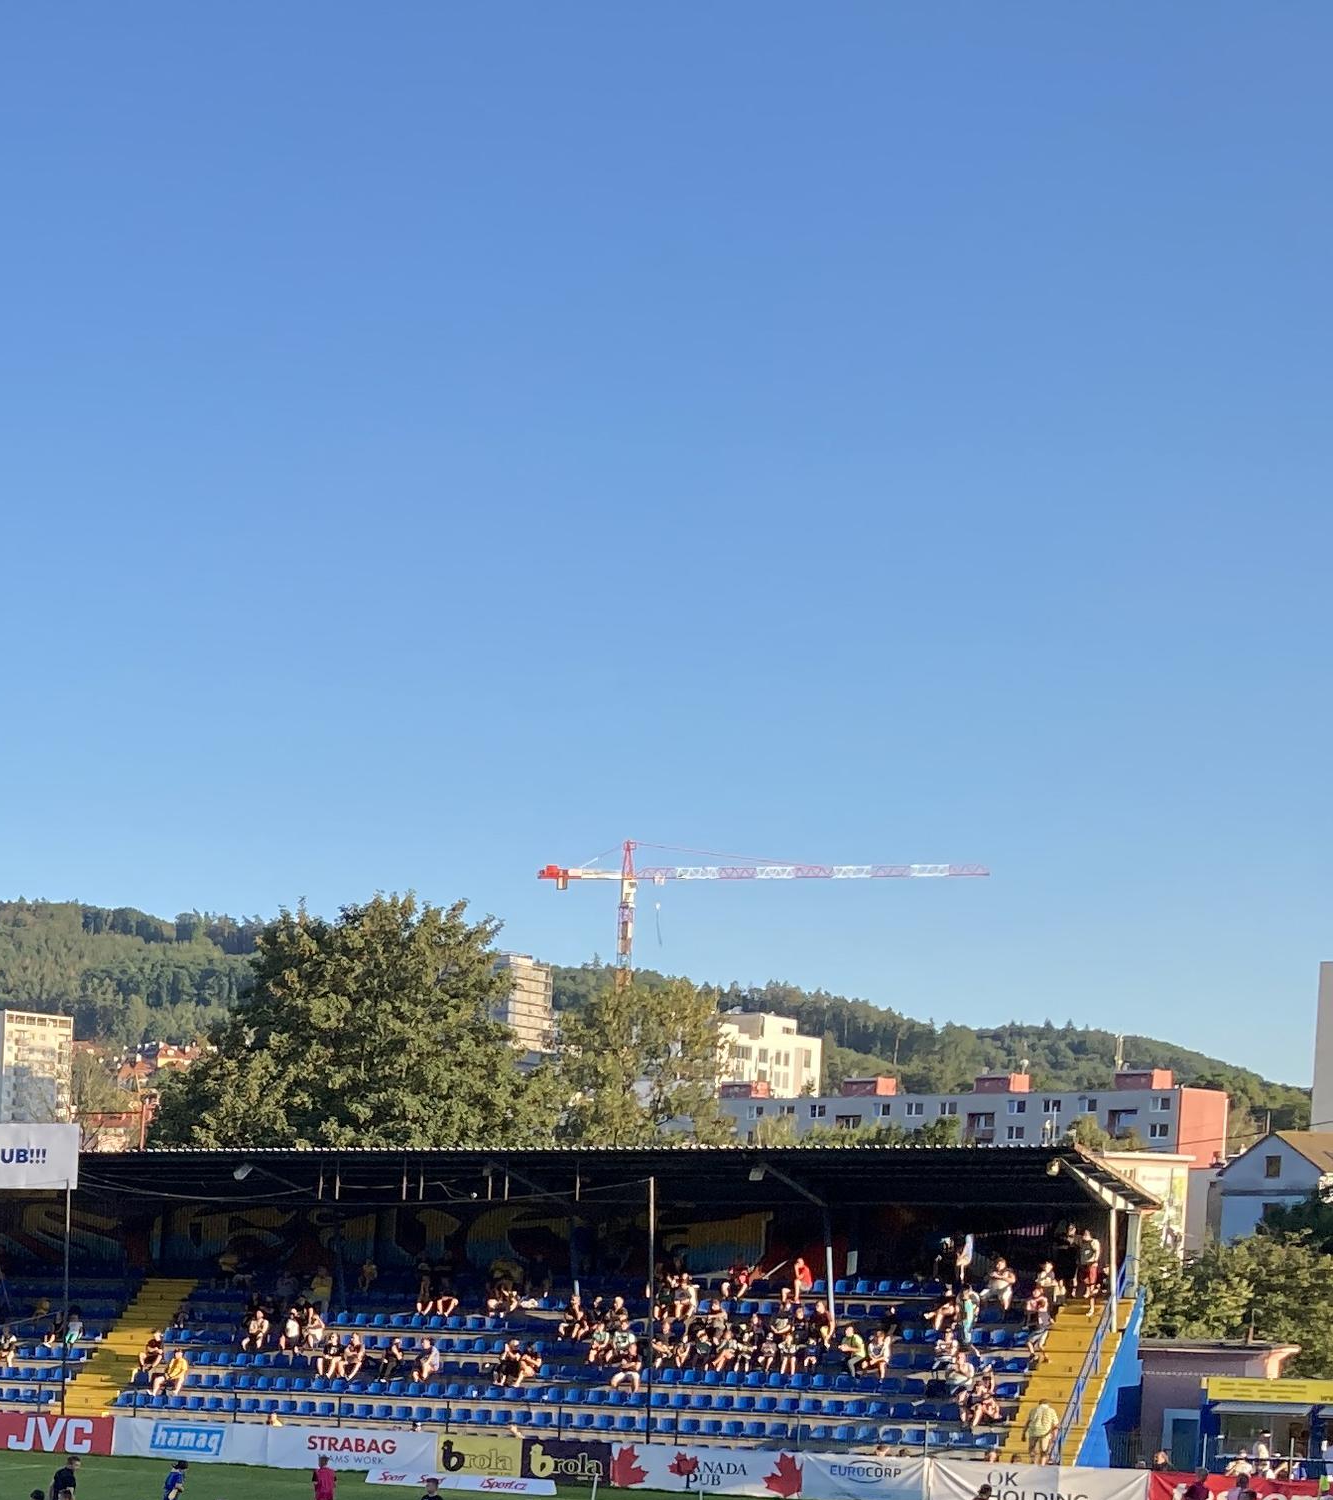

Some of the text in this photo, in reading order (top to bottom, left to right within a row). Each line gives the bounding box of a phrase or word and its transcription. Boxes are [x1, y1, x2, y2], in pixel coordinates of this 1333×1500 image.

[7, 1417, 93, 1454] JVC
[307, 1435, 397, 1454] STRABAG
[354, 1456, 383, 1465] WORK
[442, 1440, 513, 1471] brola
[530, 1443, 605, 1477] brola
[378, 1471, 406, 1482] Sport
[830, 1464, 902, 1478] EUROCORP
[988, 1471, 1018, 1487] OK
[480, 1477, 528, 1491] iSport.cz
[686, 1473, 721, 1489] PUB
